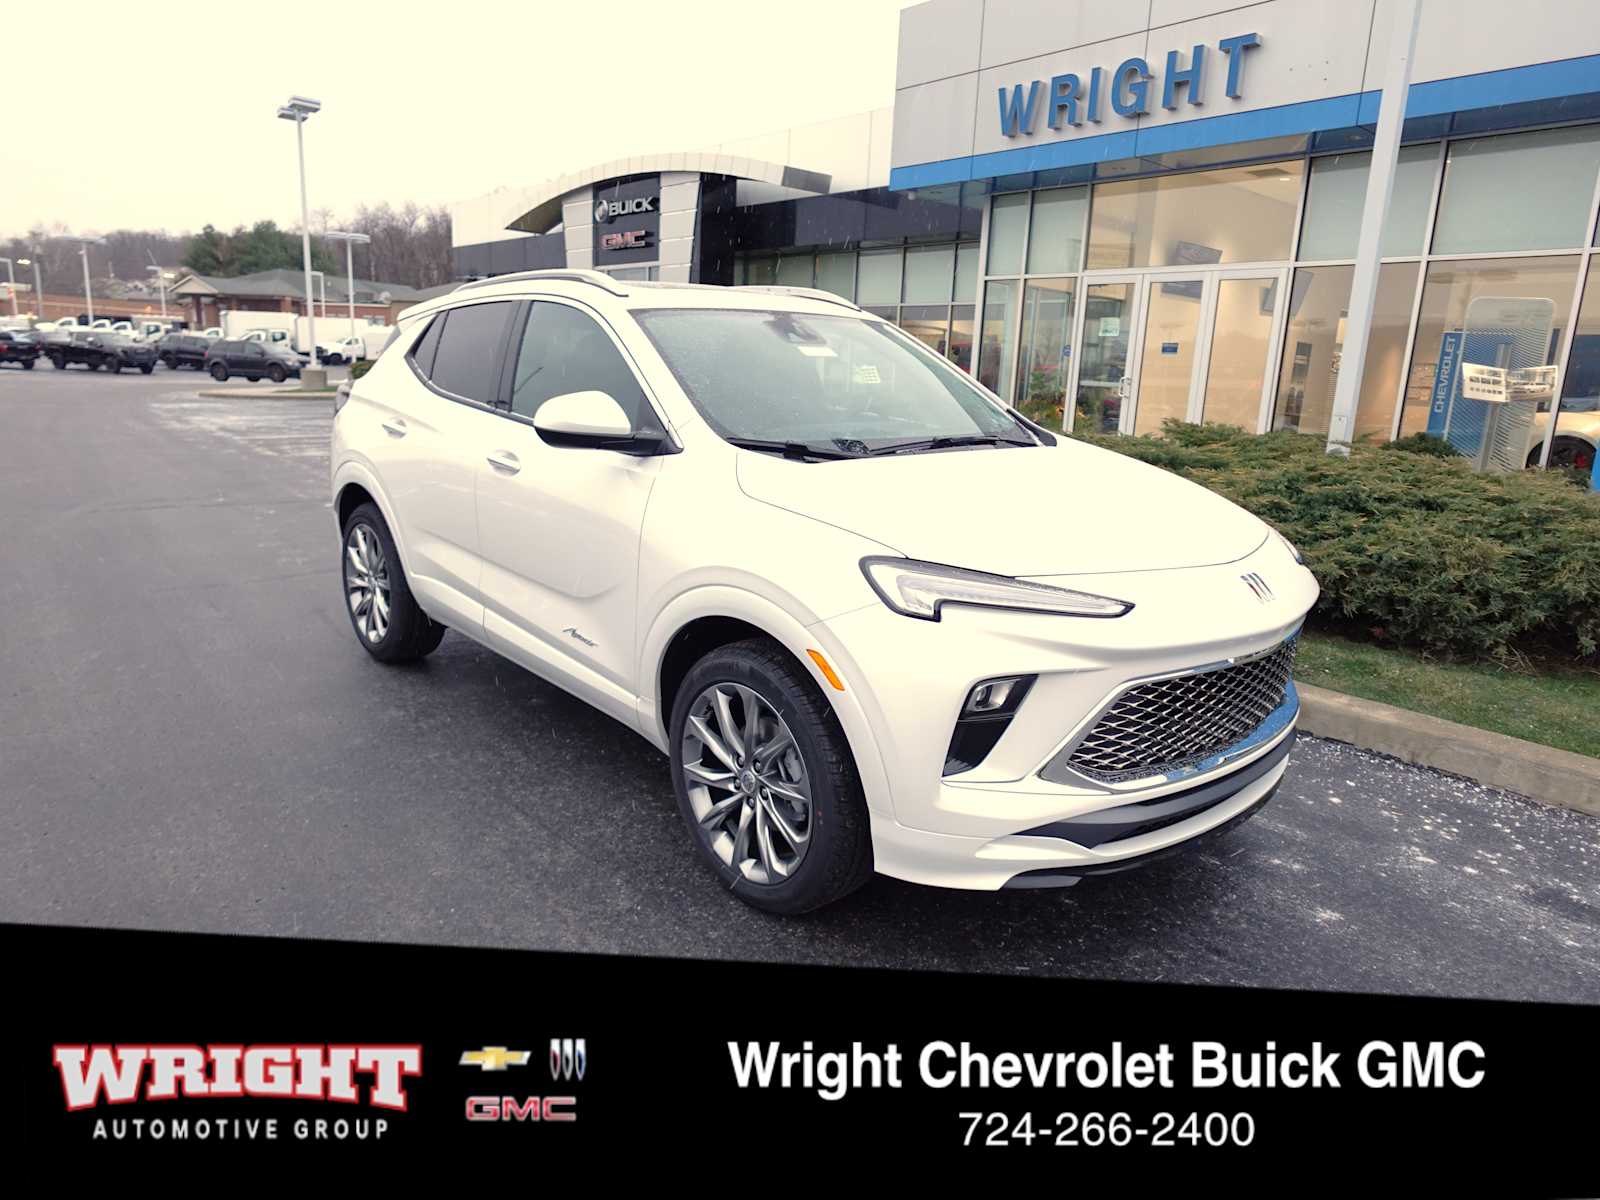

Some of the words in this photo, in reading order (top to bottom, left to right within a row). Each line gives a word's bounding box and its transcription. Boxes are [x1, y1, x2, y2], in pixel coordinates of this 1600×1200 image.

[998, 32, 1263, 138] WRIGHT
[608, 197, 654, 216] BUICK
[601, 230, 646, 249] GMC
[1433, 335, 1457, 414] CHEVROLET
